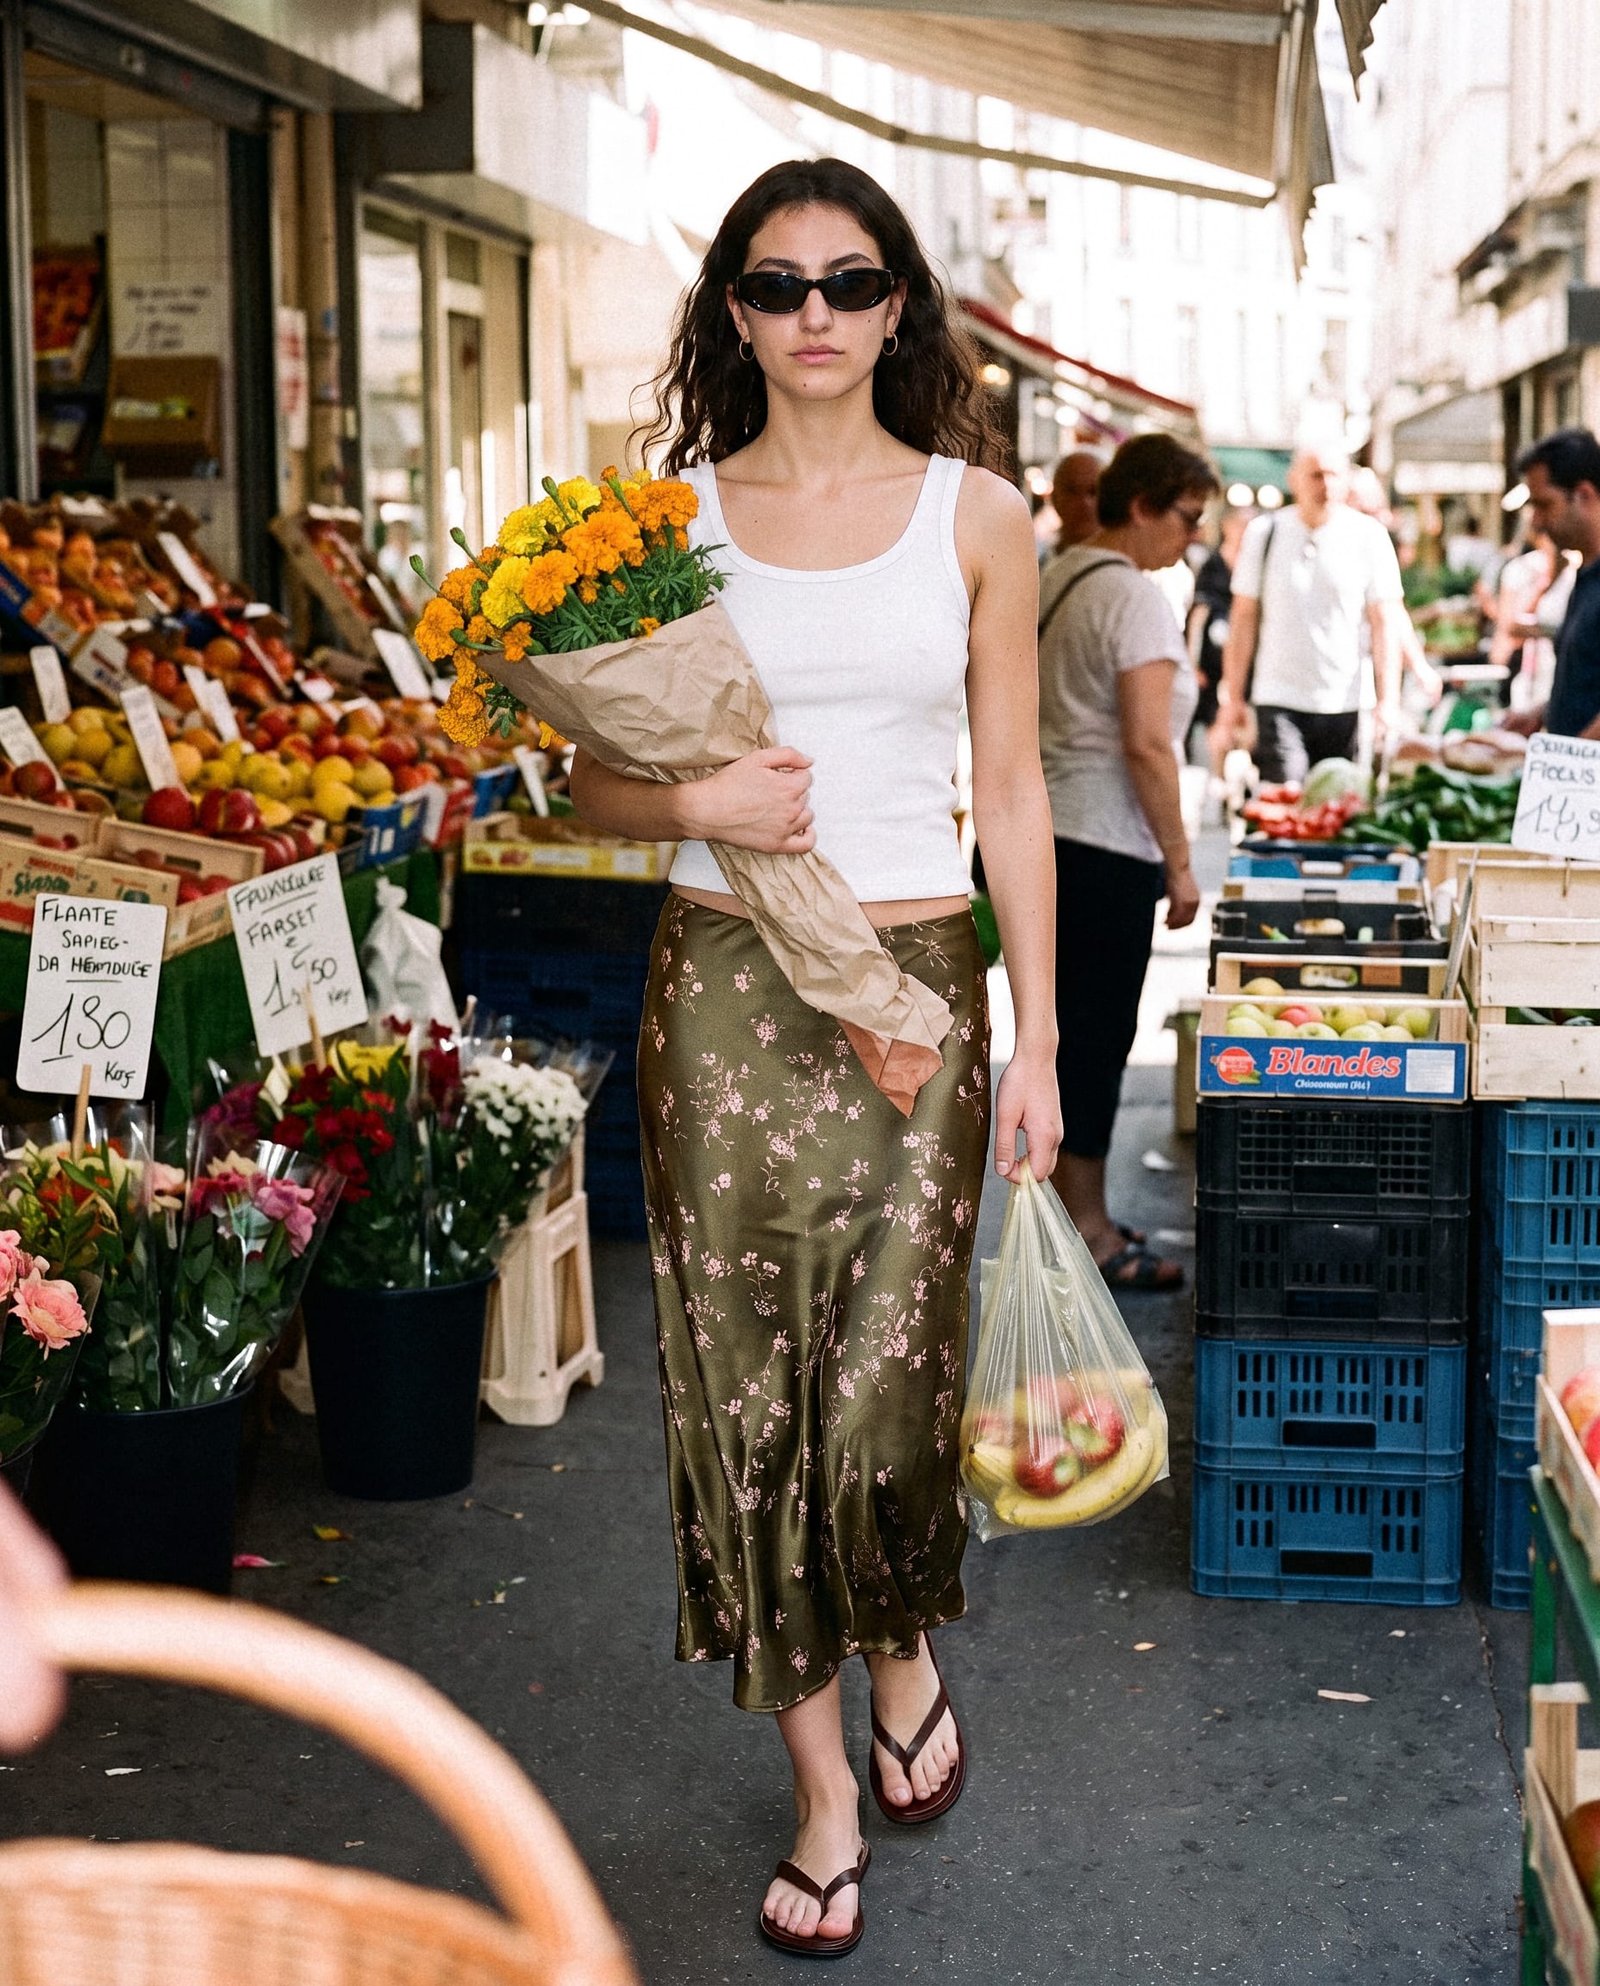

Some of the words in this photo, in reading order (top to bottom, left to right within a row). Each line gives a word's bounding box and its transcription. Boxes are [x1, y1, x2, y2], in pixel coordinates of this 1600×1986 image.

[42, 897, 118, 926] FLAATE
[246, 903, 318, 948] FARSET
[36, 954, 60, 973] DA
[1266, 1047, 1402, 1078] Blandes
